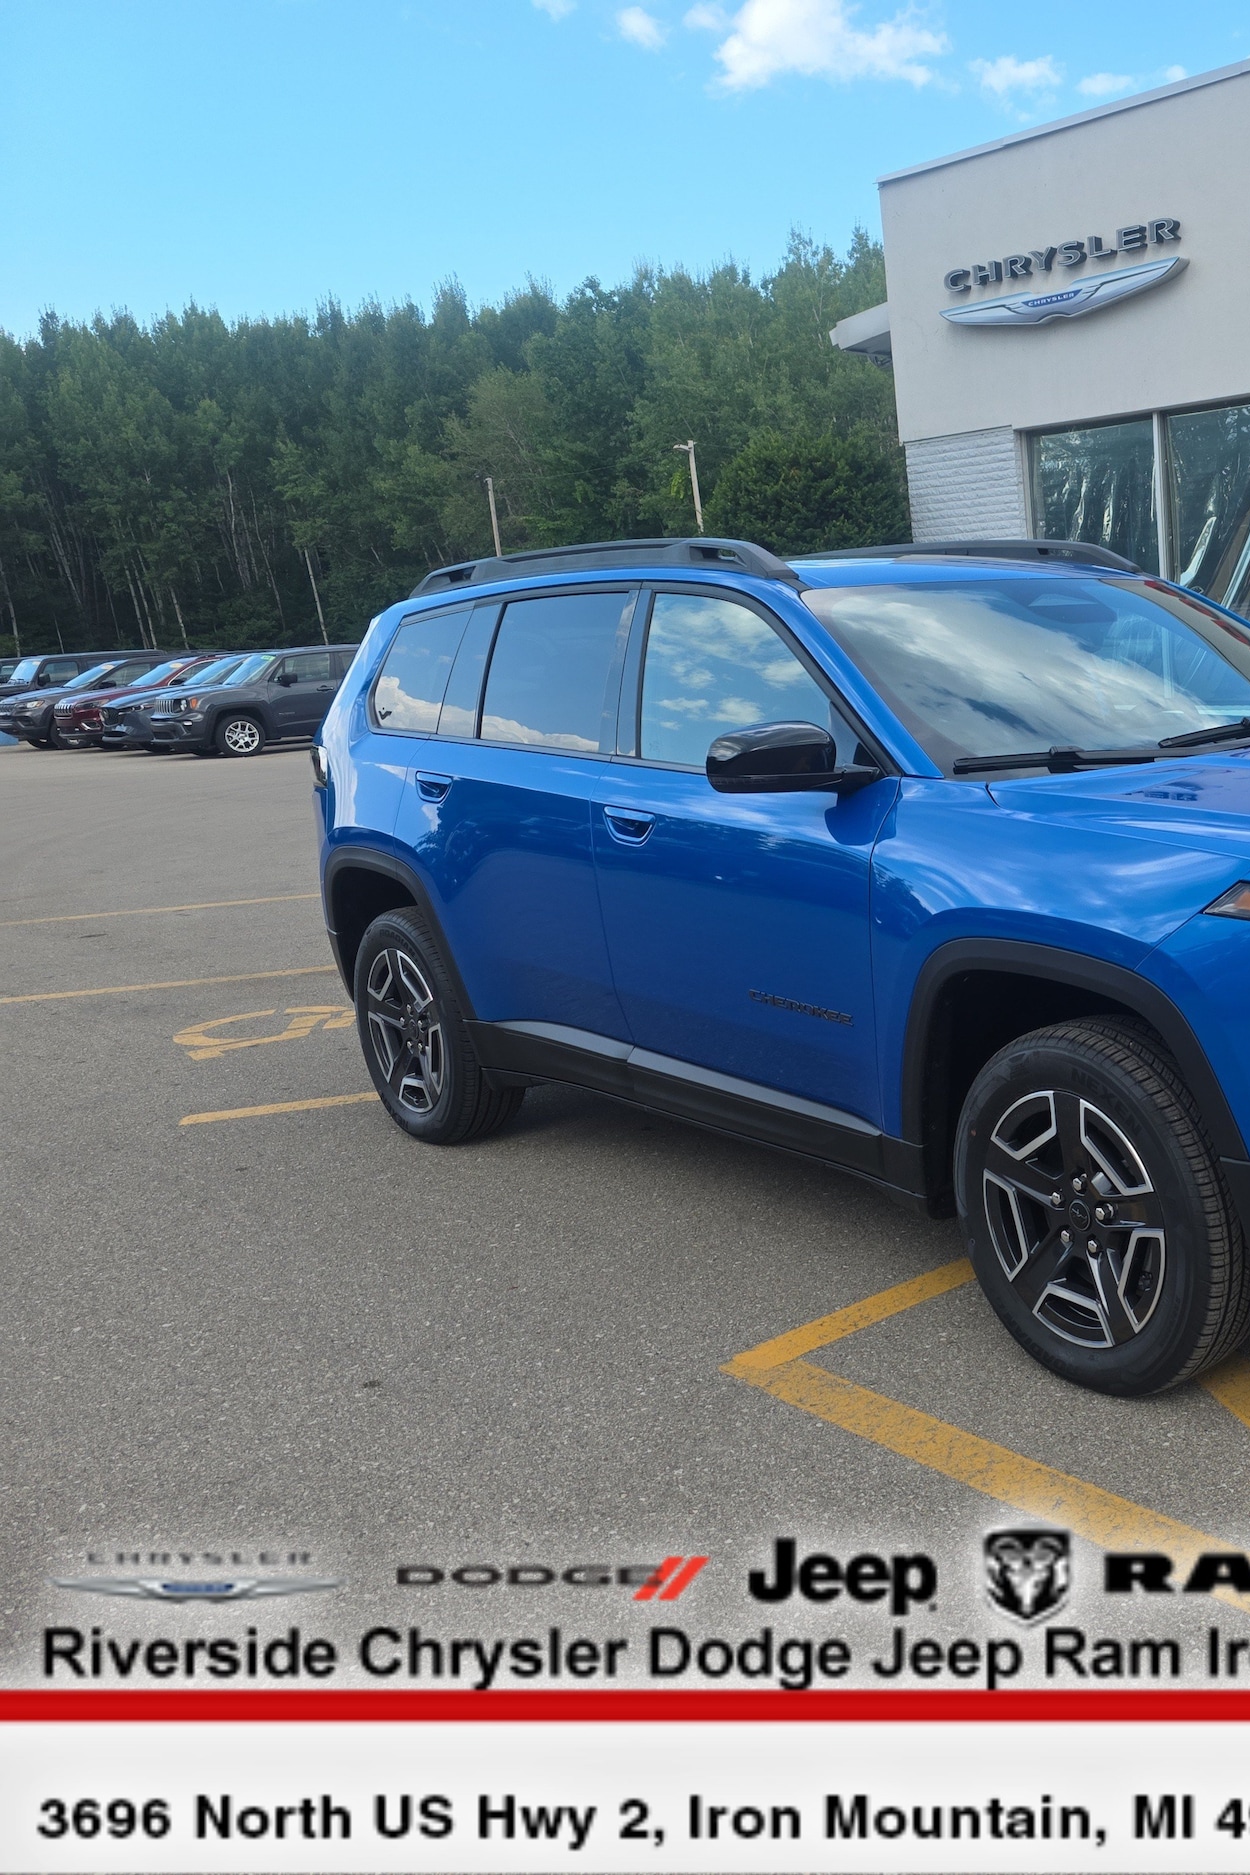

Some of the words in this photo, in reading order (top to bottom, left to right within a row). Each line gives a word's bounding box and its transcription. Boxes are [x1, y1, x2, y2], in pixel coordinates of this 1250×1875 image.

[943, 217, 1182, 293] CHRYSLER
[1027, 291, 1075, 308] CHRYSLER
[748, 988, 855, 1027] CHEROKEE
[1070, 1067, 1143, 1137] NEXEN
